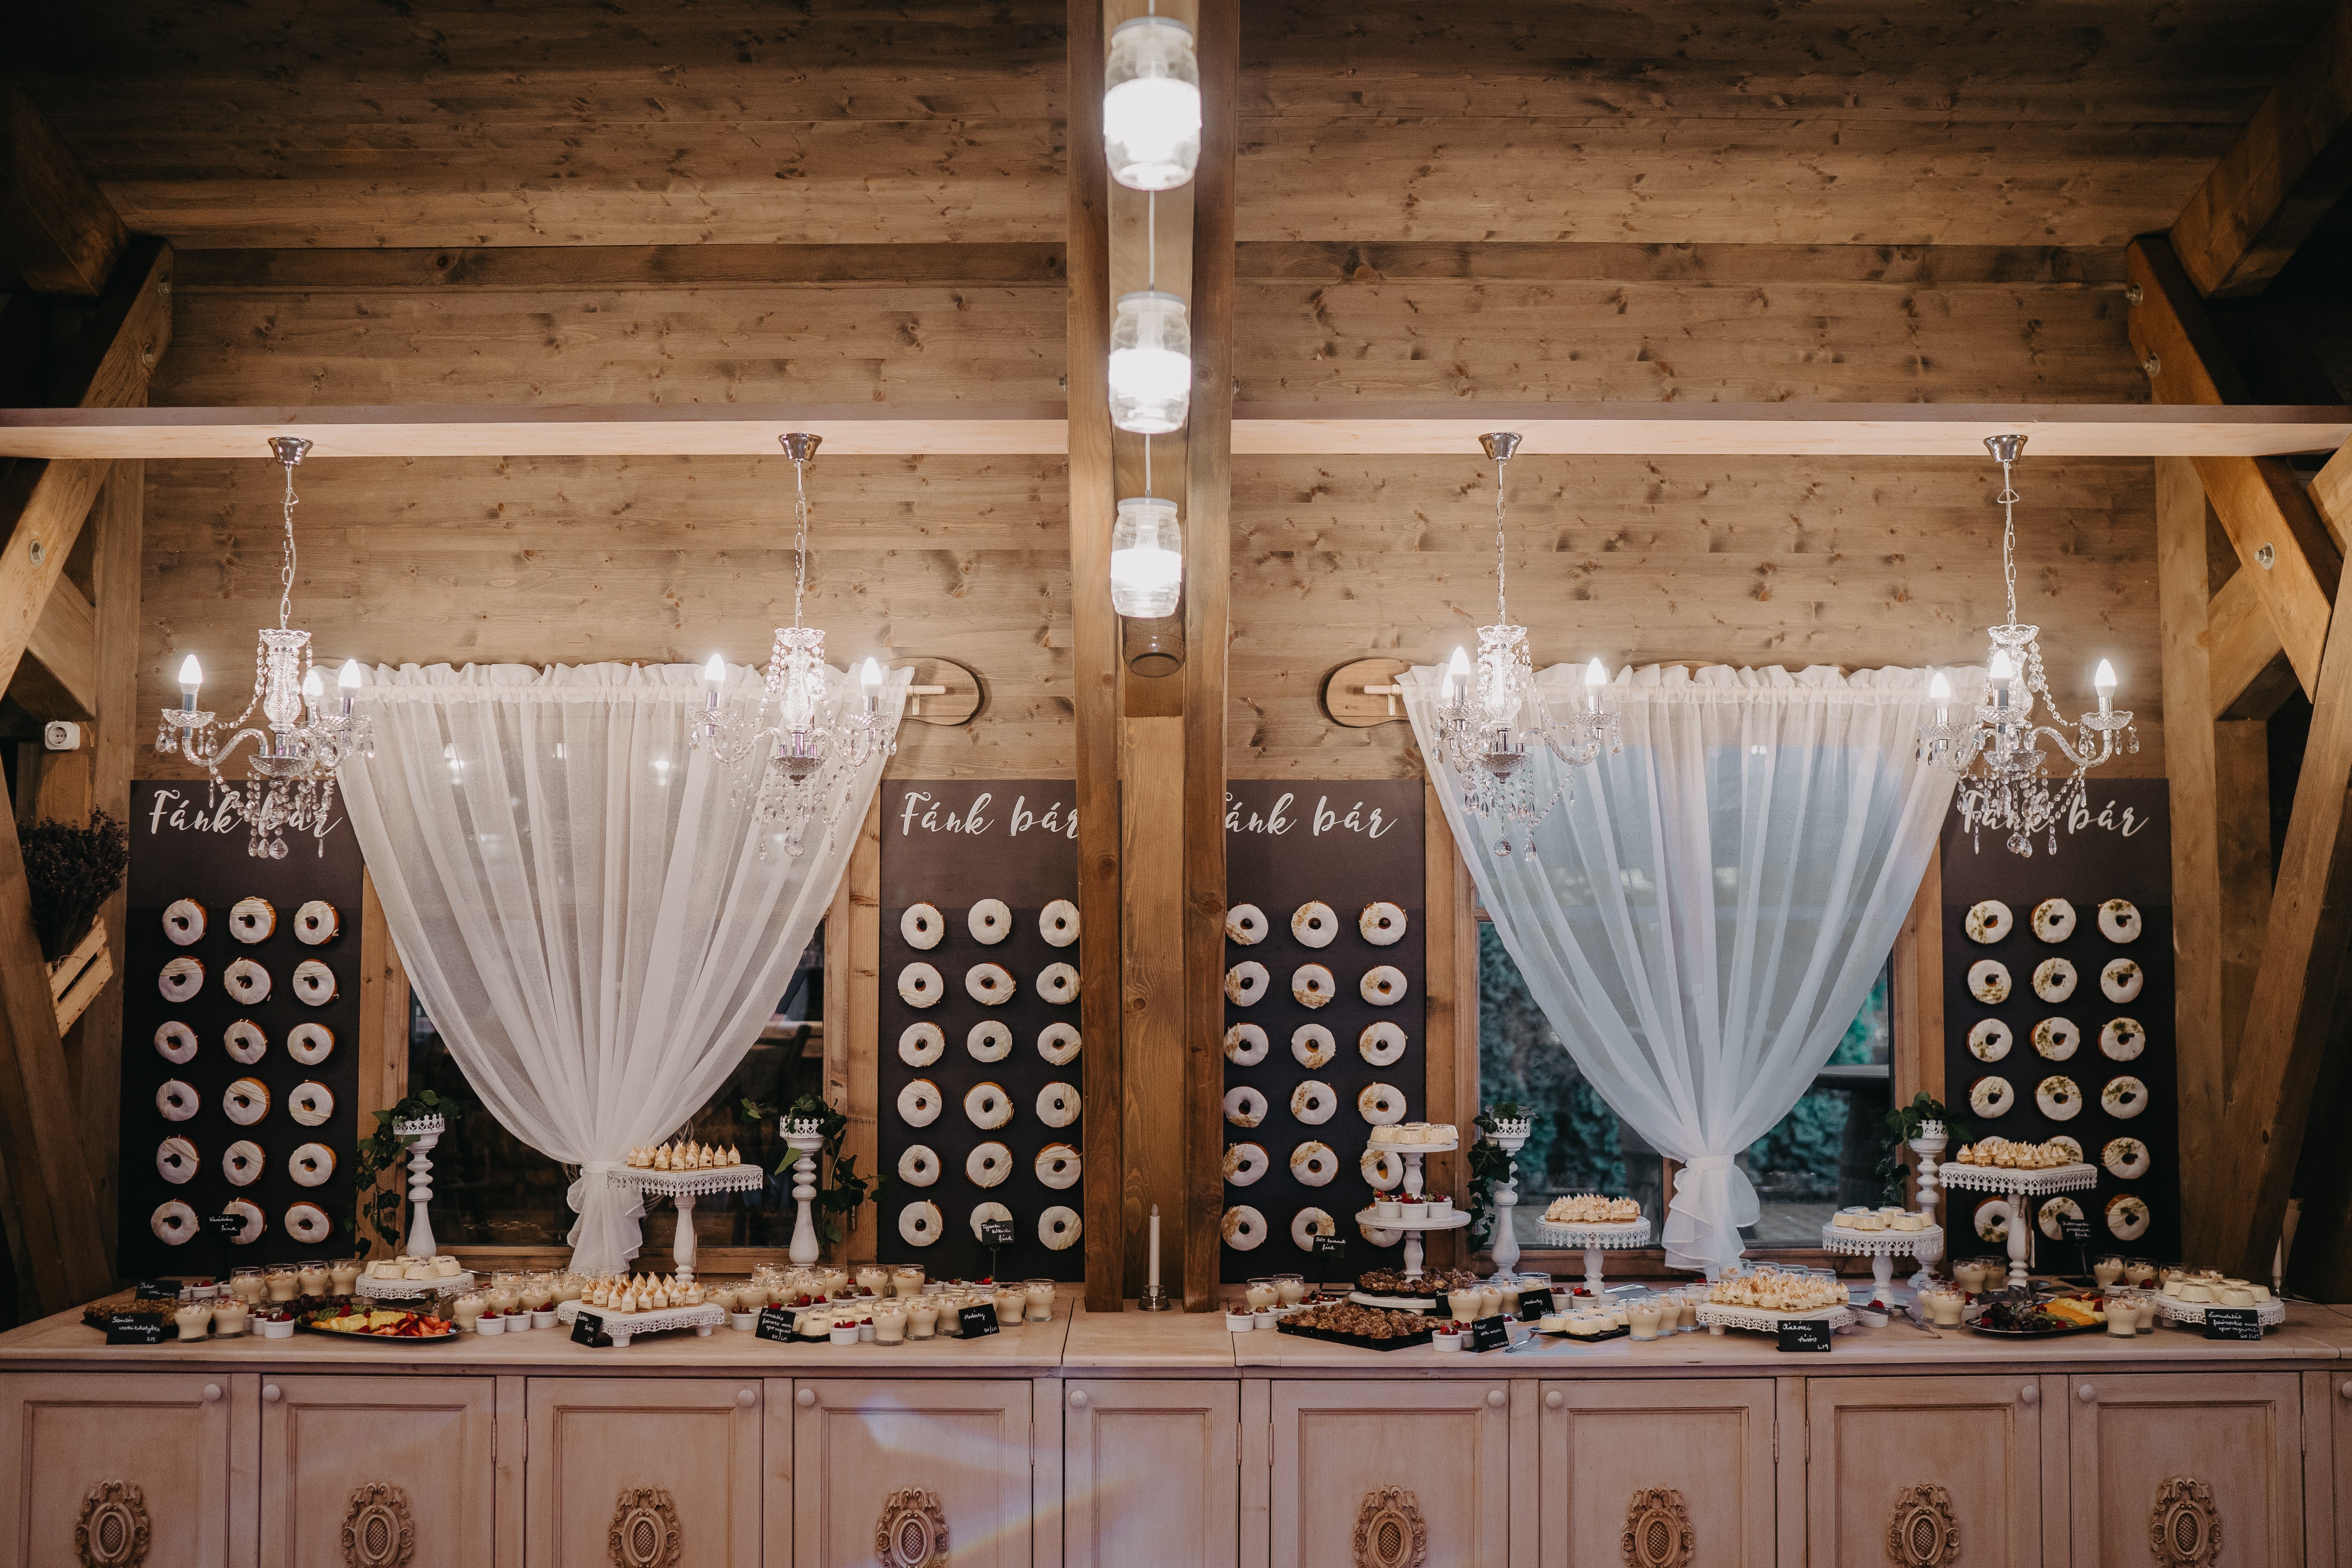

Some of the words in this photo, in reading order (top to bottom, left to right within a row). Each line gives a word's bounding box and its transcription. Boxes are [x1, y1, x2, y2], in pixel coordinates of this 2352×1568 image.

[149, 789, 242, 834] Fánk
[900, 791, 995, 836] Fánk
[1009, 795, 1078, 839] bár
[1225, 792, 1297, 835] ánk
[1313, 795, 1397, 838] bár
[2068, 794, 2149, 837] bár
[1782, 1321, 1812, 1330] Rákóczi
